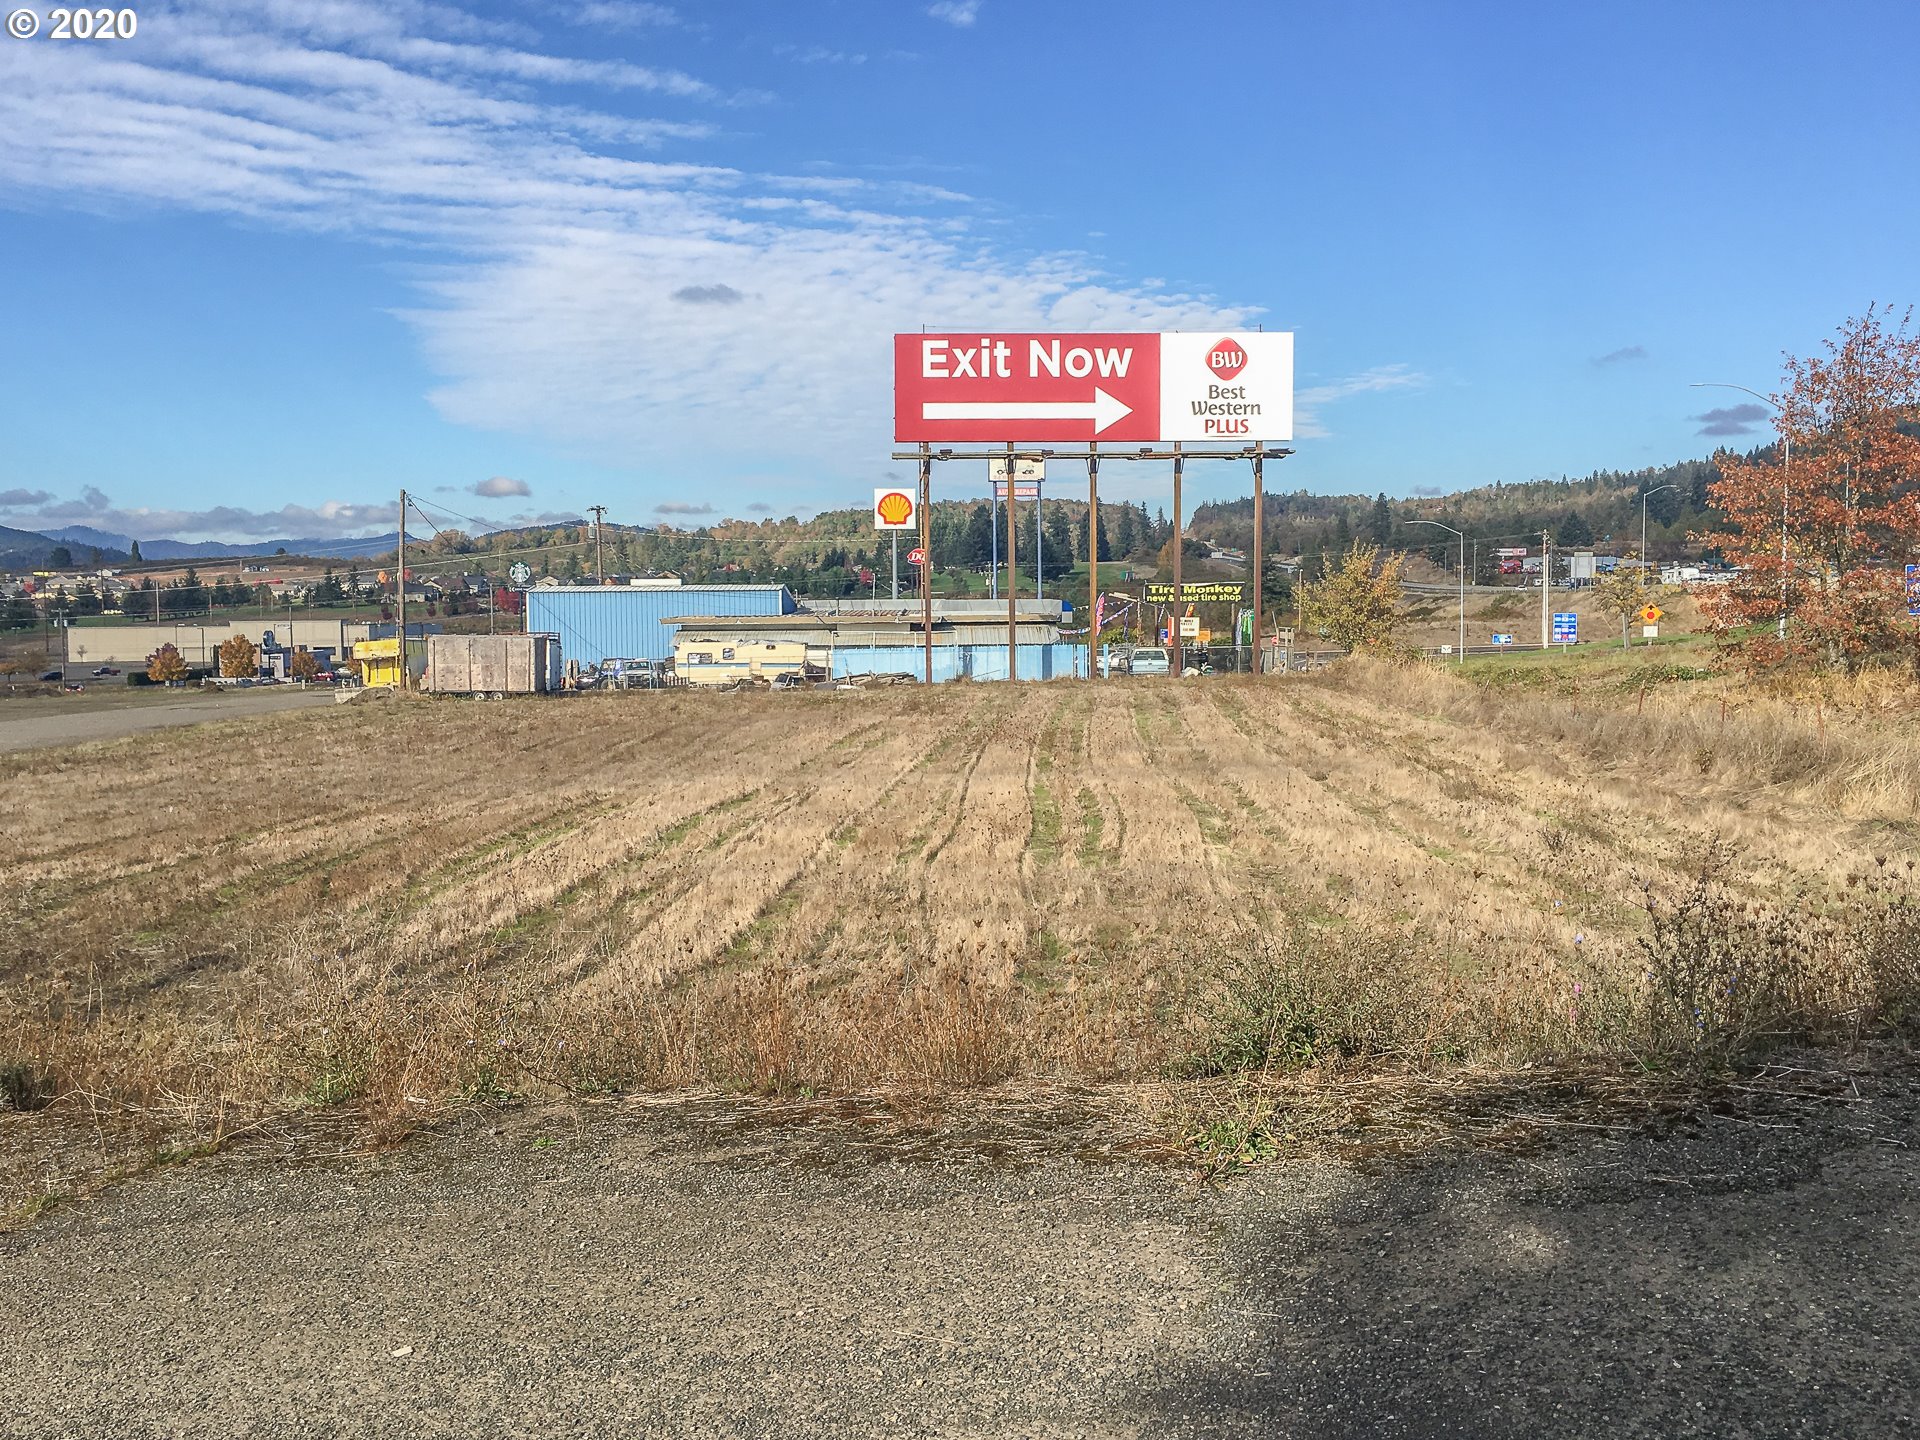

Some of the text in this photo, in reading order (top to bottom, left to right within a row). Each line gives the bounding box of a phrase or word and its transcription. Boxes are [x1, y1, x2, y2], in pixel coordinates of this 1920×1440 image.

[922, 339, 1133, 378] Exit Now
[1211, 351, 1243, 368] BW
[1208, 385, 1246, 399] Best
[1191, 400, 1261, 415] Western
[1205, 419, 1249, 433] PLUS
[1167, 594, 1175, 602] &
[1200, 594, 1217, 602] tire
[1218, 593, 1242, 602] shop
[1183, 585, 1242, 596] Monkey
